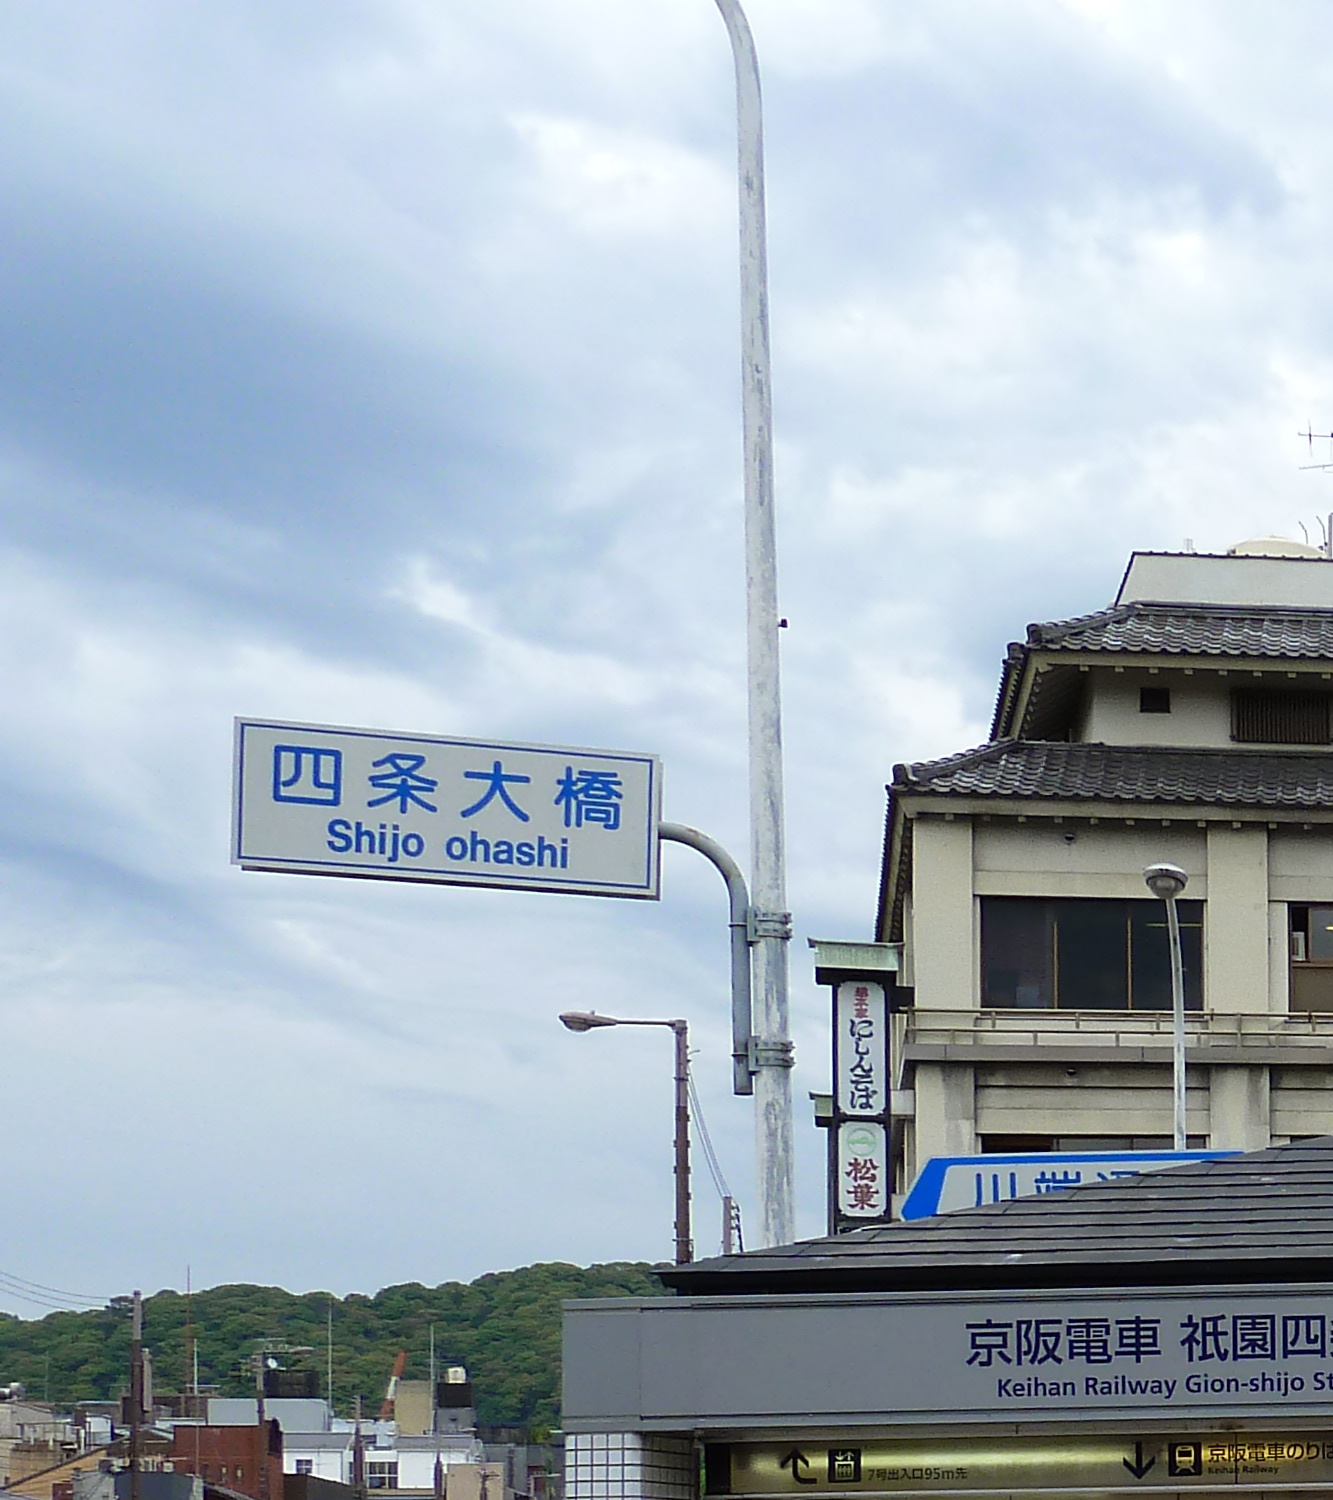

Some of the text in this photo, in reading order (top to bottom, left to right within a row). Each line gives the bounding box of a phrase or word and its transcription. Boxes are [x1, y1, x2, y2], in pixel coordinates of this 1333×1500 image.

[272, 744, 624, 831] 四条大橋
[327, 818, 569, 869] Shijo ohashi
[849, 1019, 878, 1110] にしんそば
[964, 1315, 1162, 1368] 京阪電車
[997, 1376, 1077, 1399] Keihan
[1083, 1374, 1177, 1401] Railway
[1184, 1372, 1306, 1398] Gion-shijo
[867, 1467, 969, 1482] 7号出入口95m先
[1242, 1464, 1280, 1476] Railway
